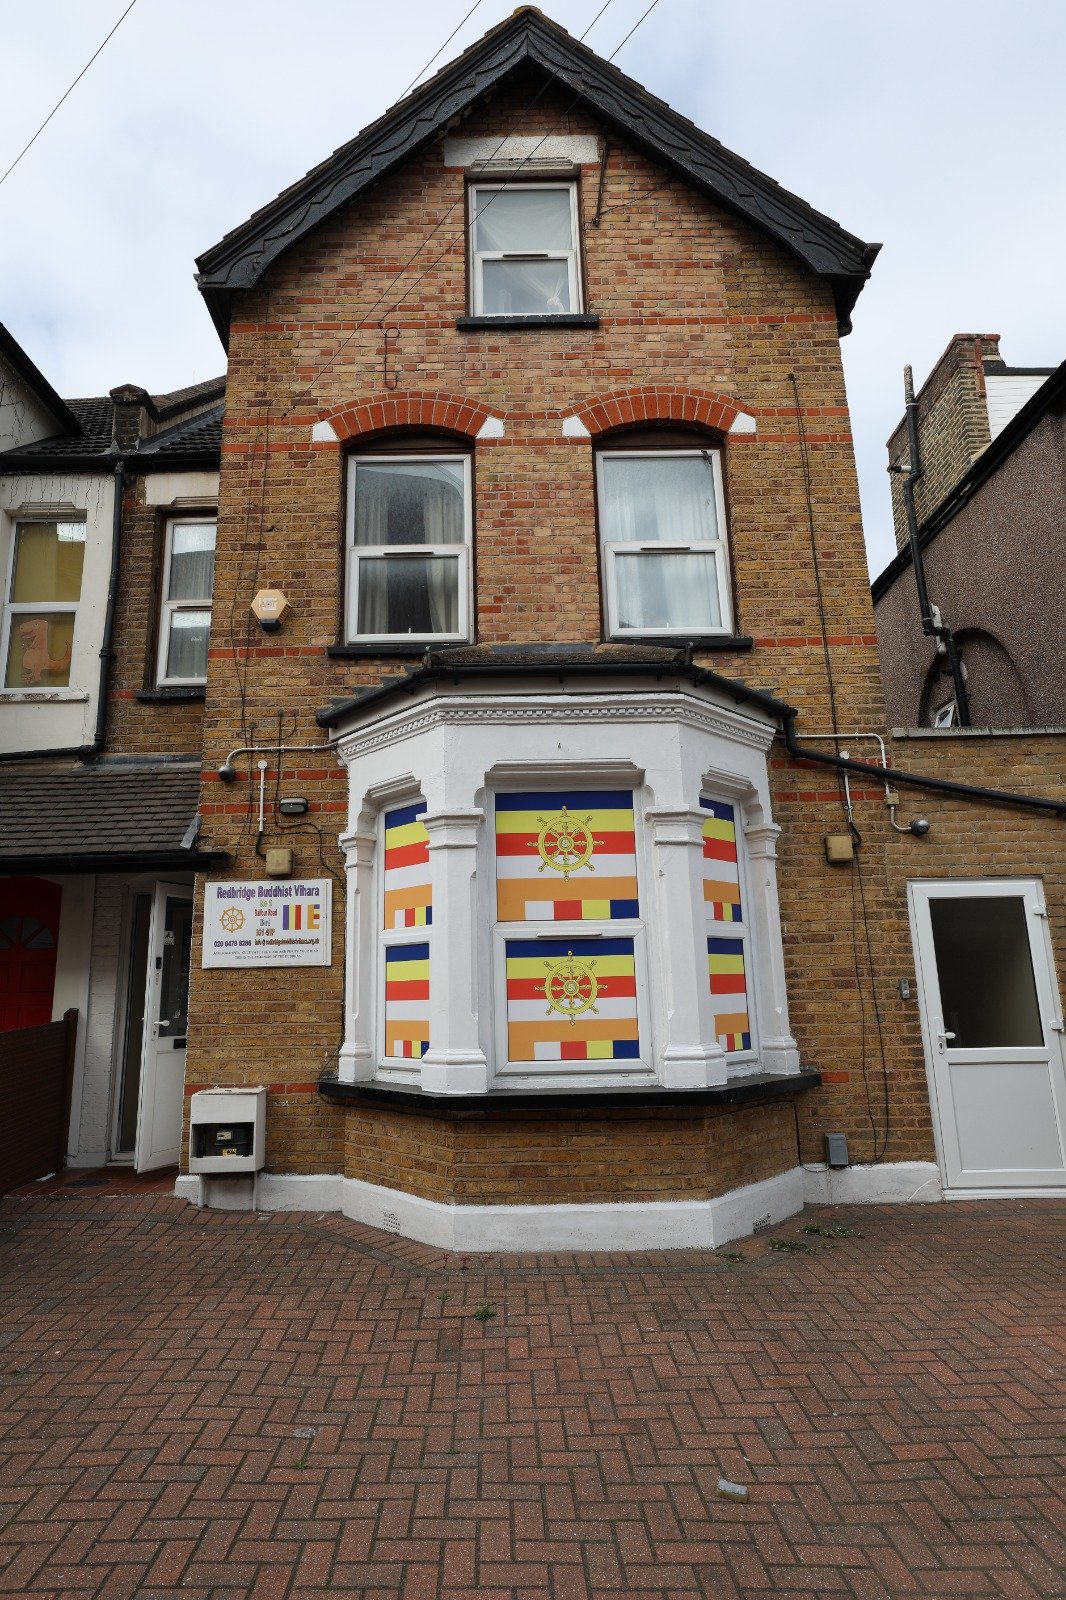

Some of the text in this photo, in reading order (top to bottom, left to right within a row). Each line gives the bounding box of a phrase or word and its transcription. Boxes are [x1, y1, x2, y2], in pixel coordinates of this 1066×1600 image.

[217, 885, 320, 901] Redbridge Buddhist Vihara
